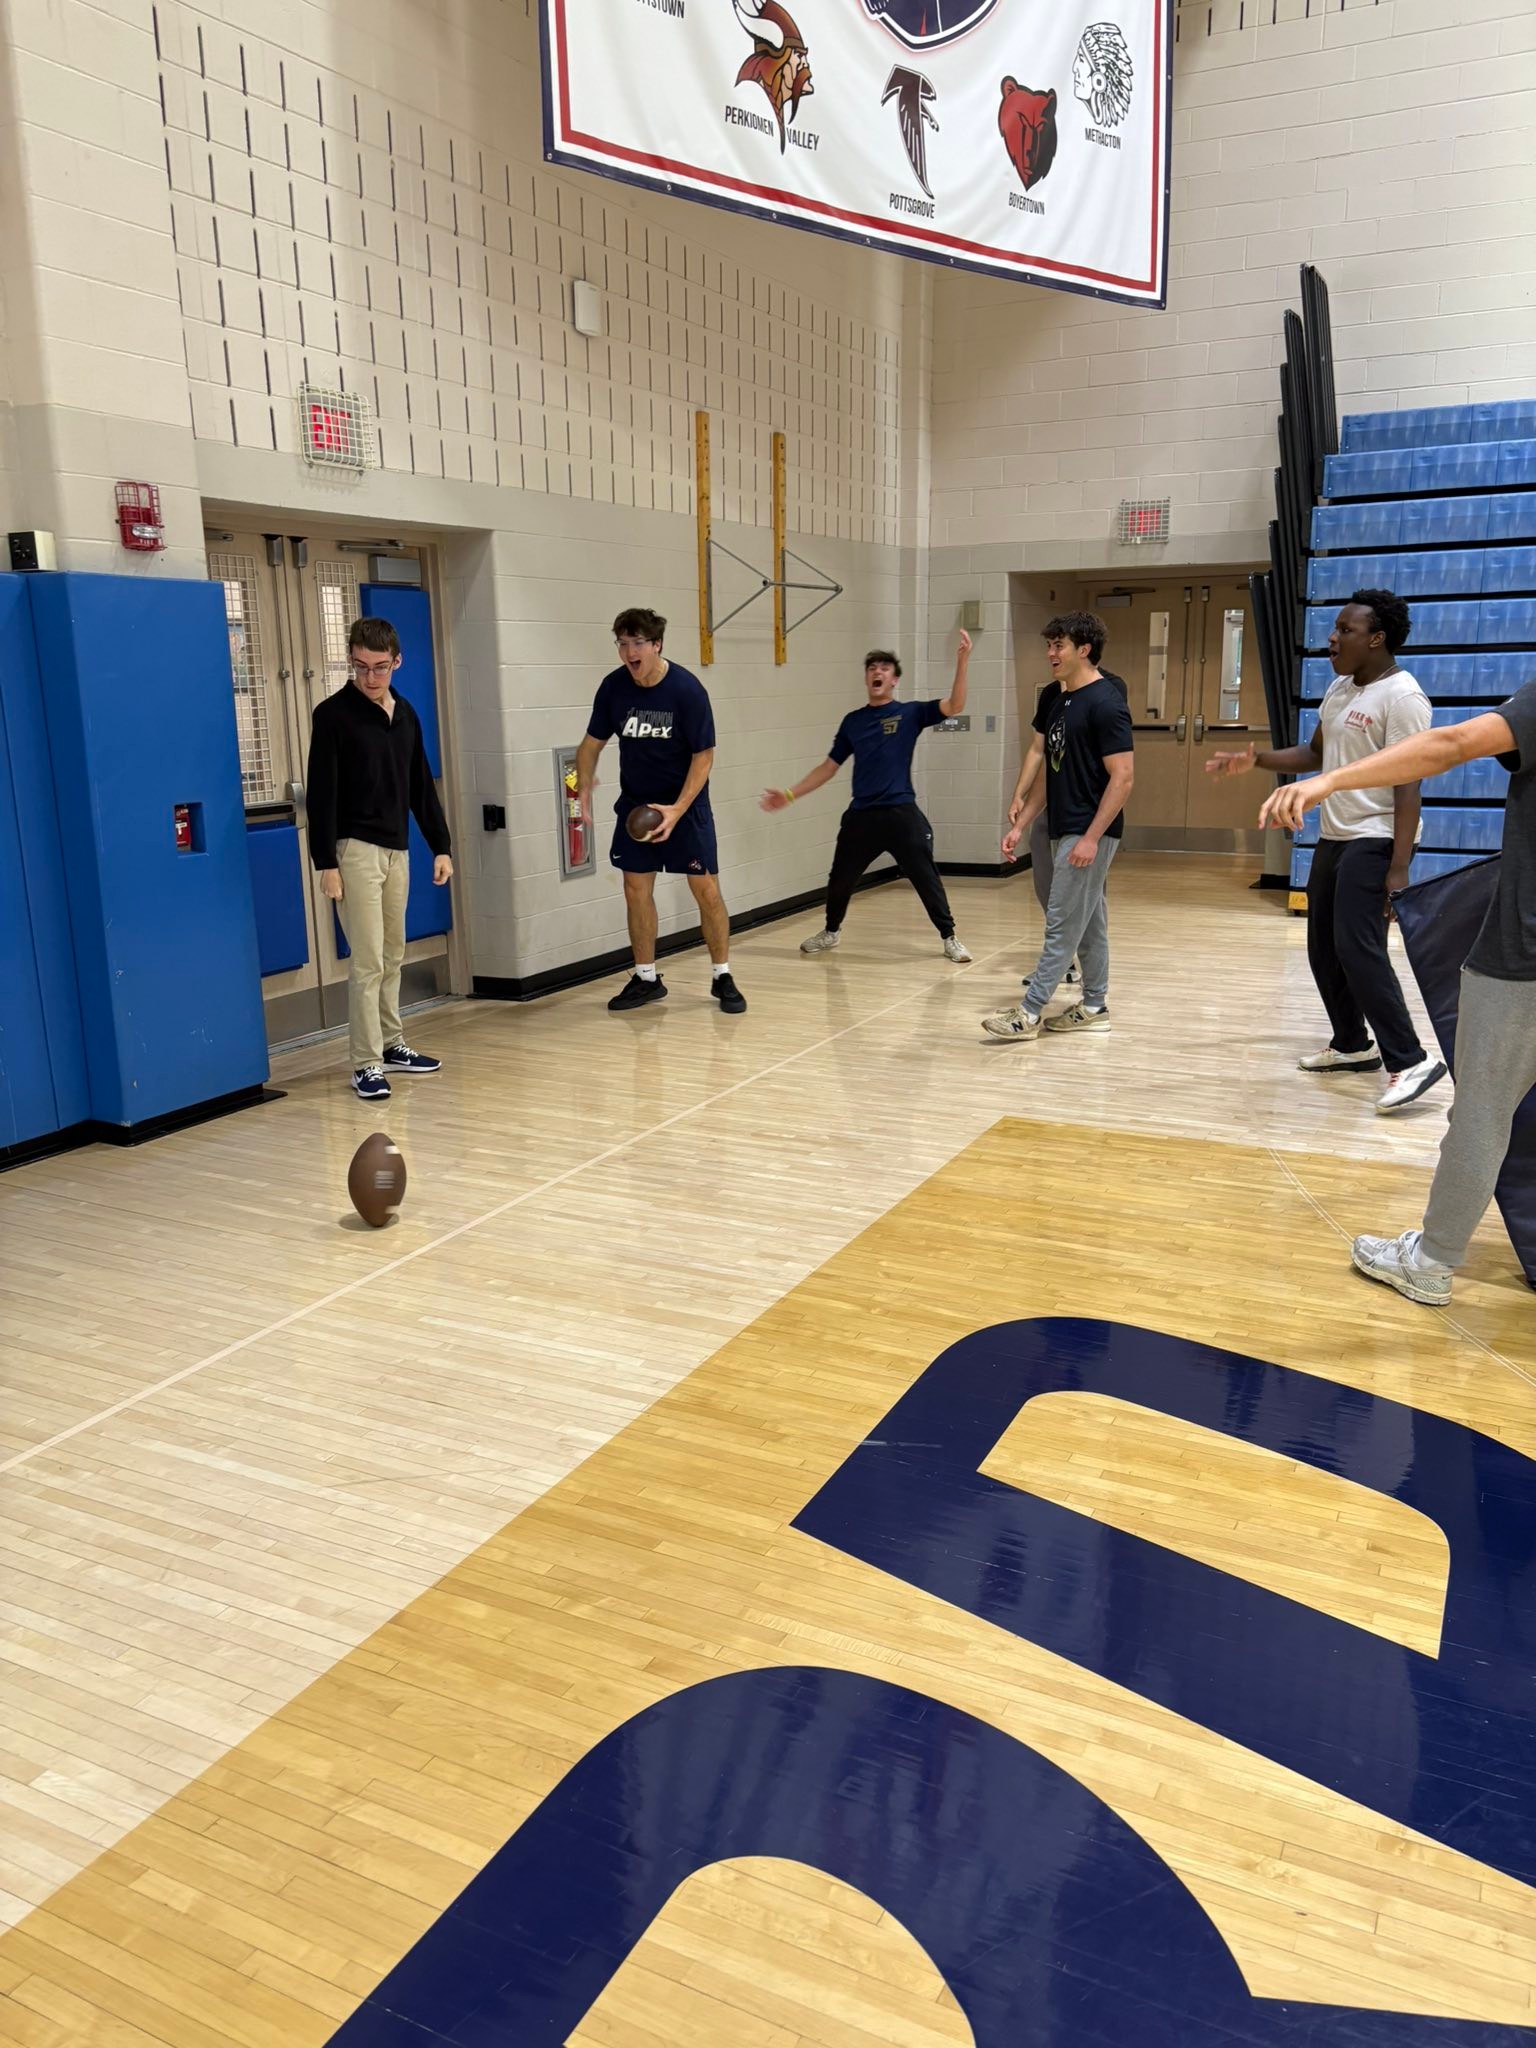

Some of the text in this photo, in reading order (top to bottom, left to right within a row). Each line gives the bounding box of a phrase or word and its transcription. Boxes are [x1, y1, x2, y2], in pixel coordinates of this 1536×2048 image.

[636, 0, 685, 19] STOWN
[725, 105, 820, 151] PERKIOMEN VALLEY
[889, 193, 935, 219] POTTSGROVE
[1008, 191, 1045, 215] BOYERTOWN
[622, 716, 673, 739] APEX
